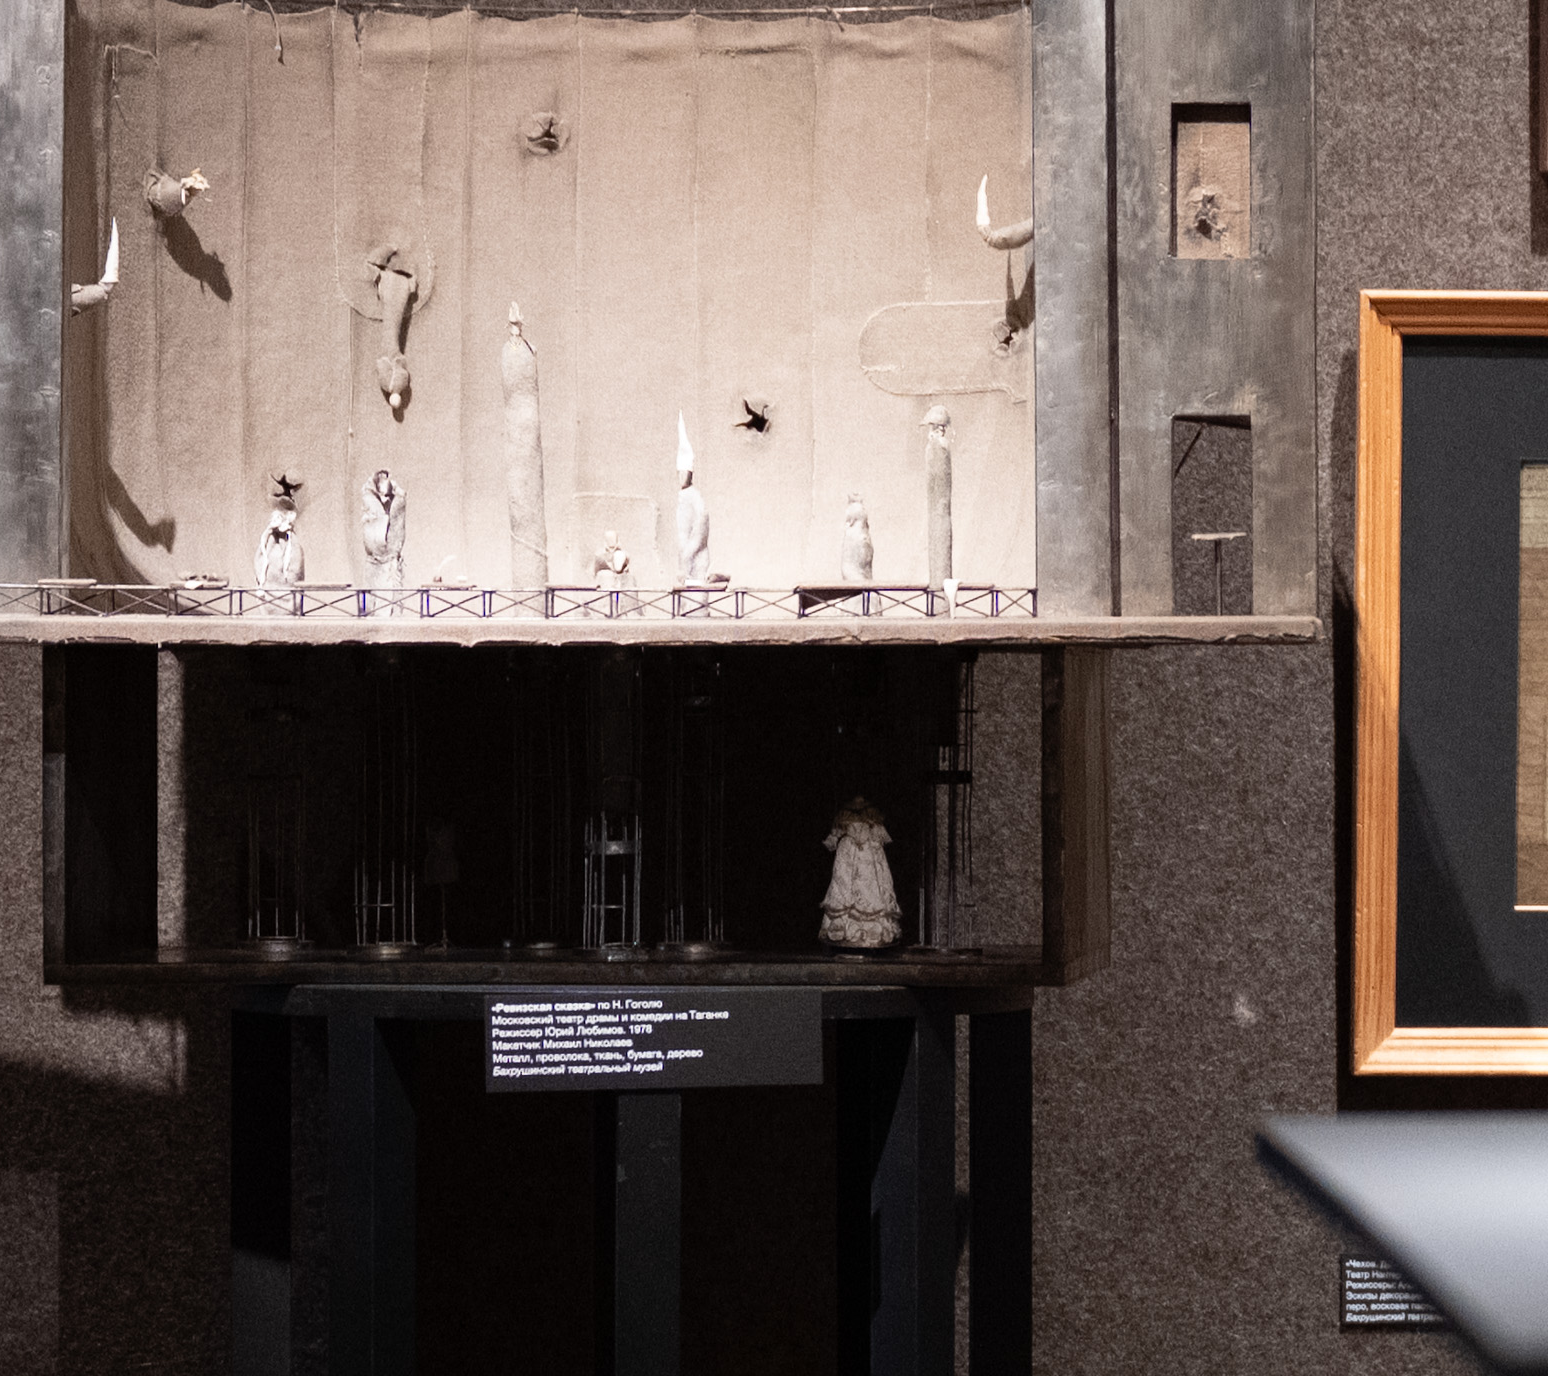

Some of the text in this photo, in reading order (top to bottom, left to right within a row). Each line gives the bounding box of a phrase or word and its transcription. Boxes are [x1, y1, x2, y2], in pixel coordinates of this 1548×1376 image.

[597, 1001, 611, 1010] по
[612, 999, 623, 1009] Н.
[625, 999, 663, 1009] Гоголю
[491, 1010, 730, 1025] Московский театр драмы и комедии на Таганке
[492, 1027, 543, 1038] Режиссер
[544, 1026, 575, 1038] Юрий
[628, 1024, 653, 1034] 1978
[492, 1038, 634, 1051] Макетчик Михаил Николаев
[492, 1053, 534, 1064] Металл,
[535, 1052, 593, 1064] проволока,
[627, 1049, 665, 1062] бумага,
[666, 1049, 704, 1060] дерево
[492, 1061, 664, 1078] Бахрушинский театральный музей
[1345, 1270, 1370, 1280] Театр
